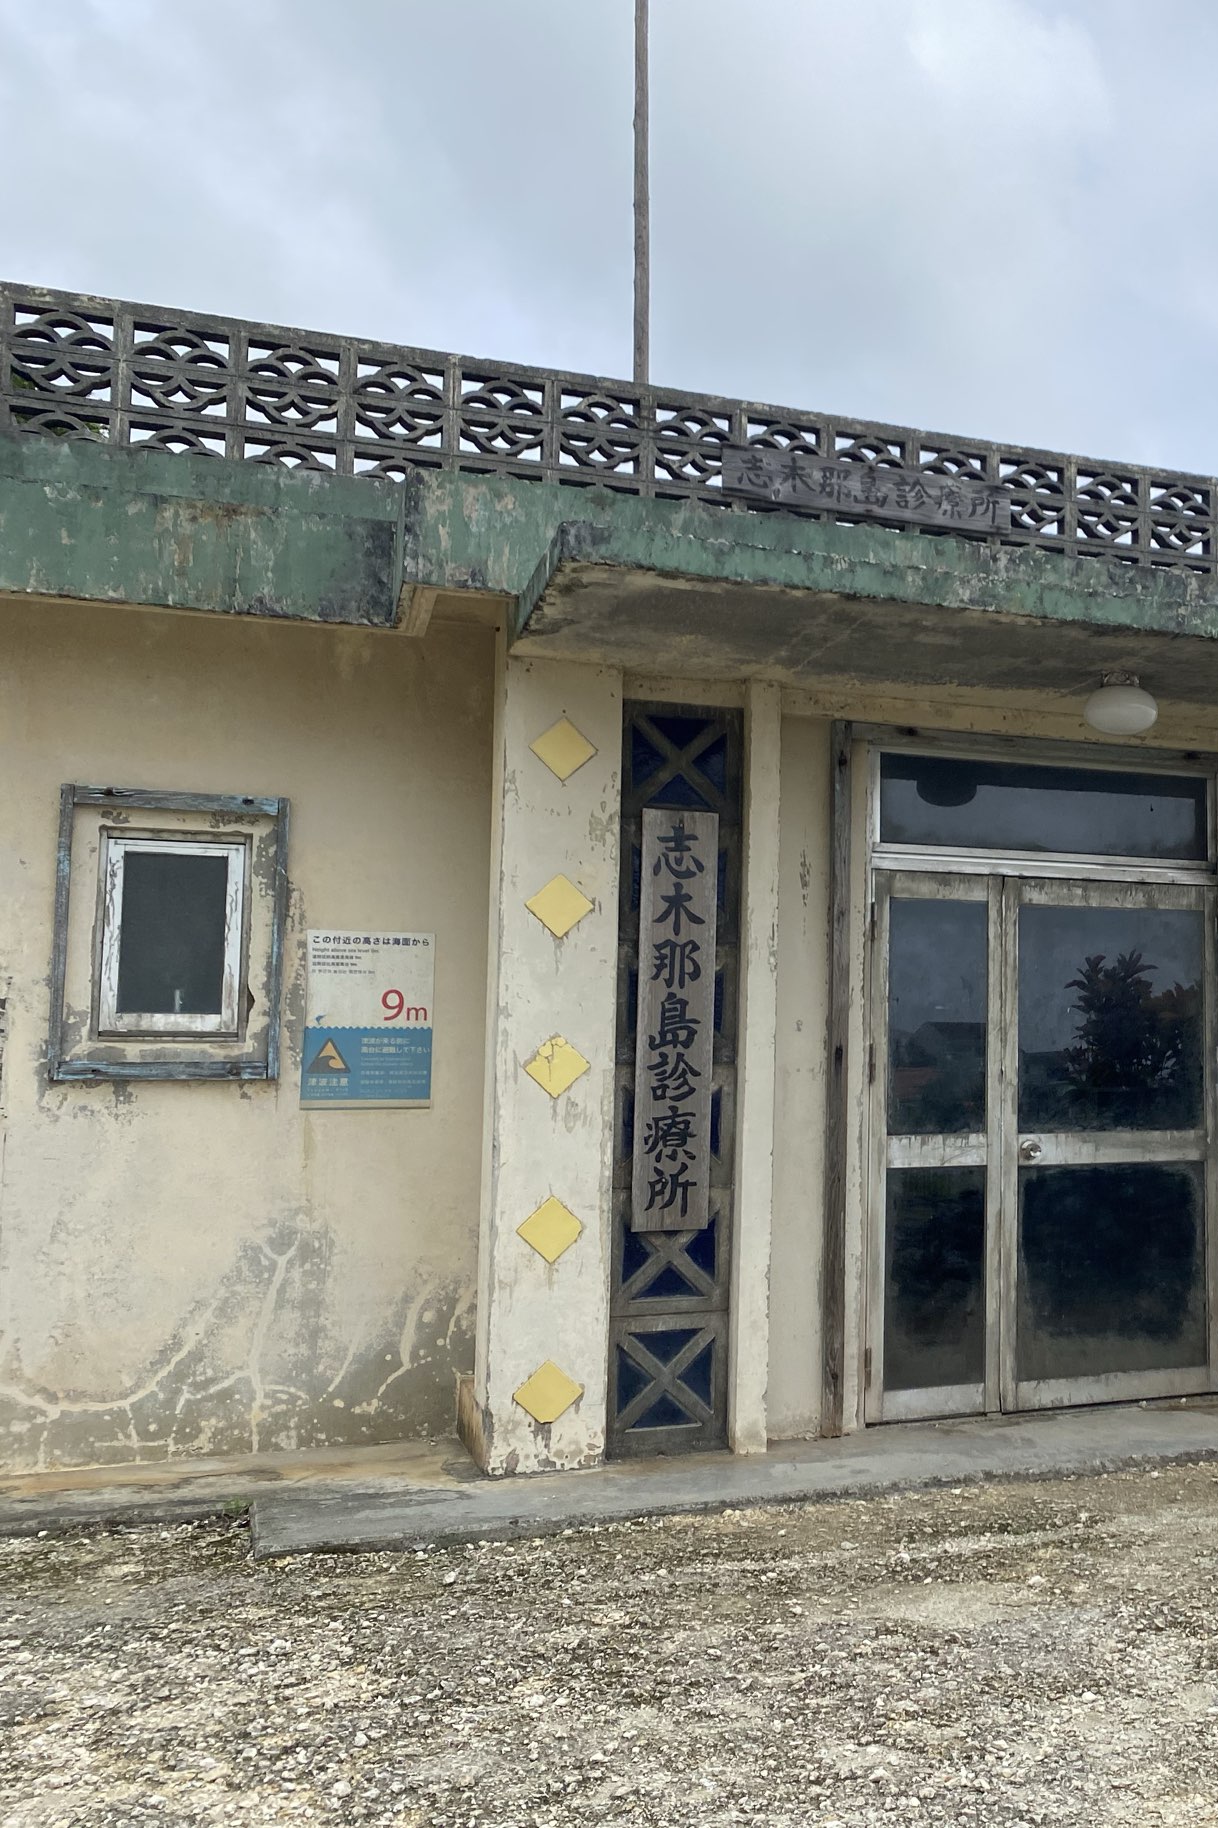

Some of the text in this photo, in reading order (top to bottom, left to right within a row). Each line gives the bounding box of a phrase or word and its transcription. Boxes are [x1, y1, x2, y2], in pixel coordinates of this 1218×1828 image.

[738, 456, 999, 523] 志木那島診療所
[312, 935, 430, 946] この付近の高さは海面から
[381, 989, 428, 1021] 9m
[642, 825, 705, 1218] 志木那島診療所
